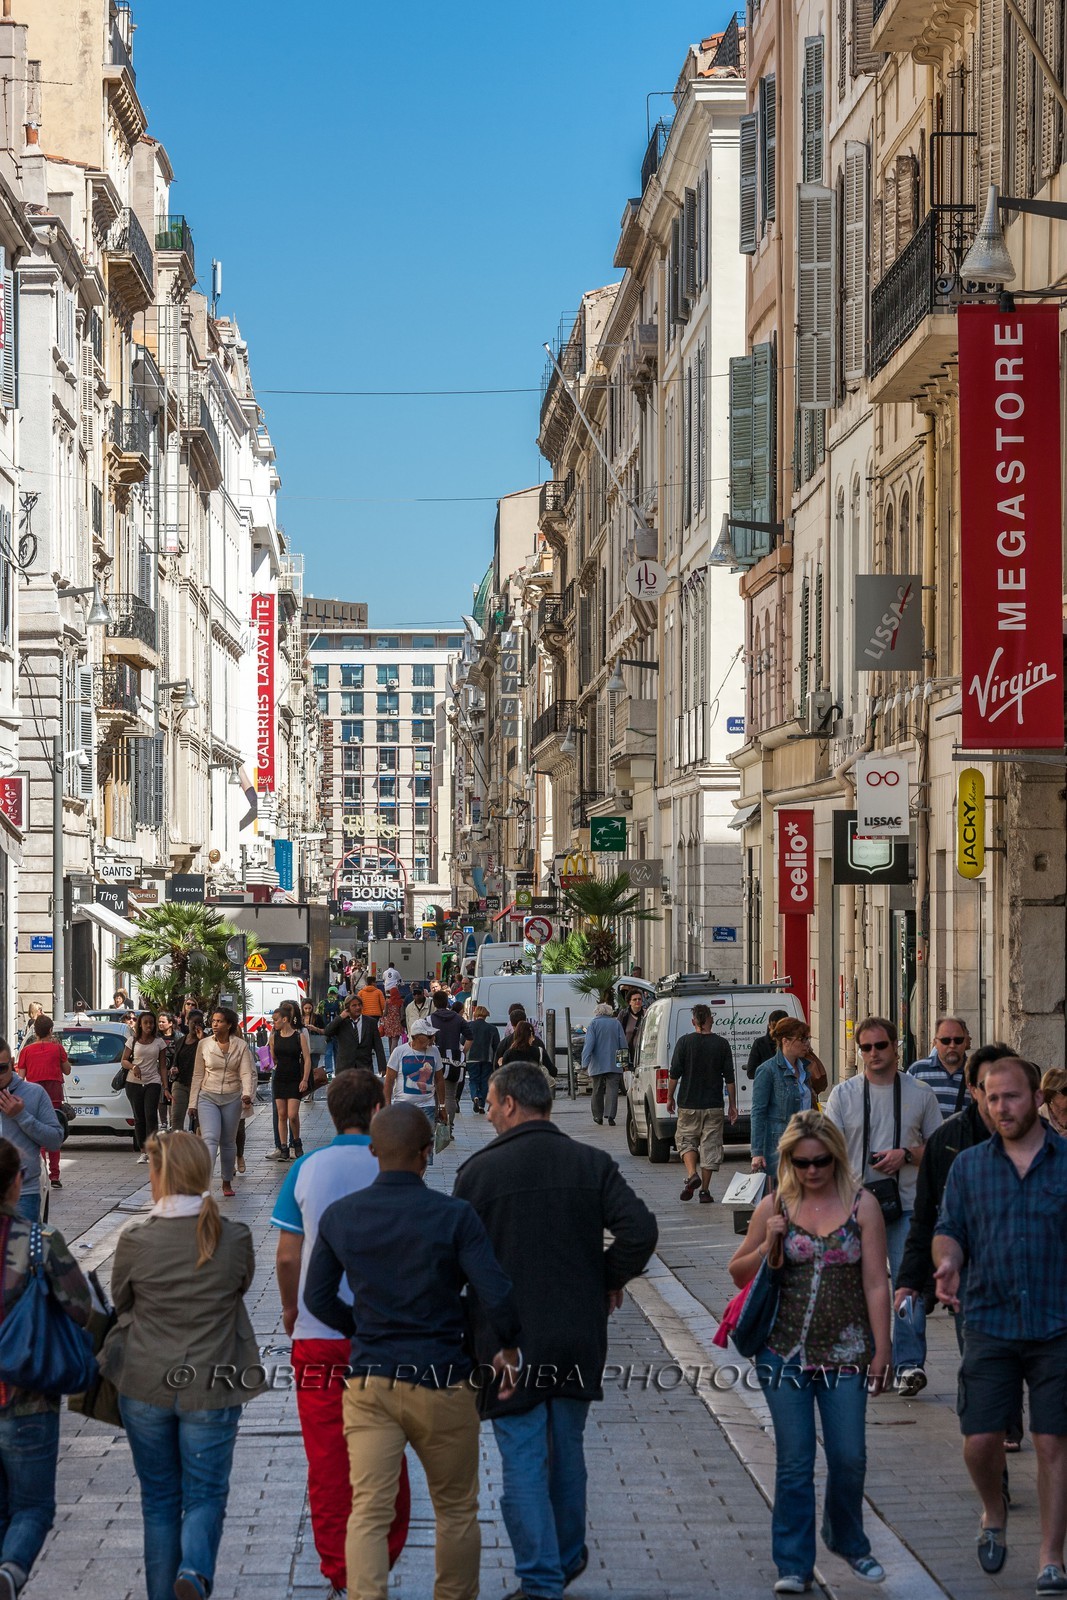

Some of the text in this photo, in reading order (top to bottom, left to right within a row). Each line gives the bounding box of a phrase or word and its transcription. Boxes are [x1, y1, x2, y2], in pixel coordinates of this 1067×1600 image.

[993, 323, 1027, 632] MEGASTORE
[863, 584, 915, 660] LISSAC
[256, 600, 269, 686] LAFAYETTE
[502, 633, 516, 736] HOTEL
[968, 646, 1057, 725] Virgin
[257, 694, 269, 769] GALERIES
[341, 814, 387, 827] CENTRE
[864, 816, 902, 827] LISSAC
[347, 826, 400, 839] BOURSE
[102, 866, 132, 877] GANTS
[343, 874, 393, 885] CENTRE
[99, 891, 118, 901] The
[352, 887, 405, 899] BOURSE
[114, 901, 124, 910] M
[712, 1011, 767, 1030] cofroid
